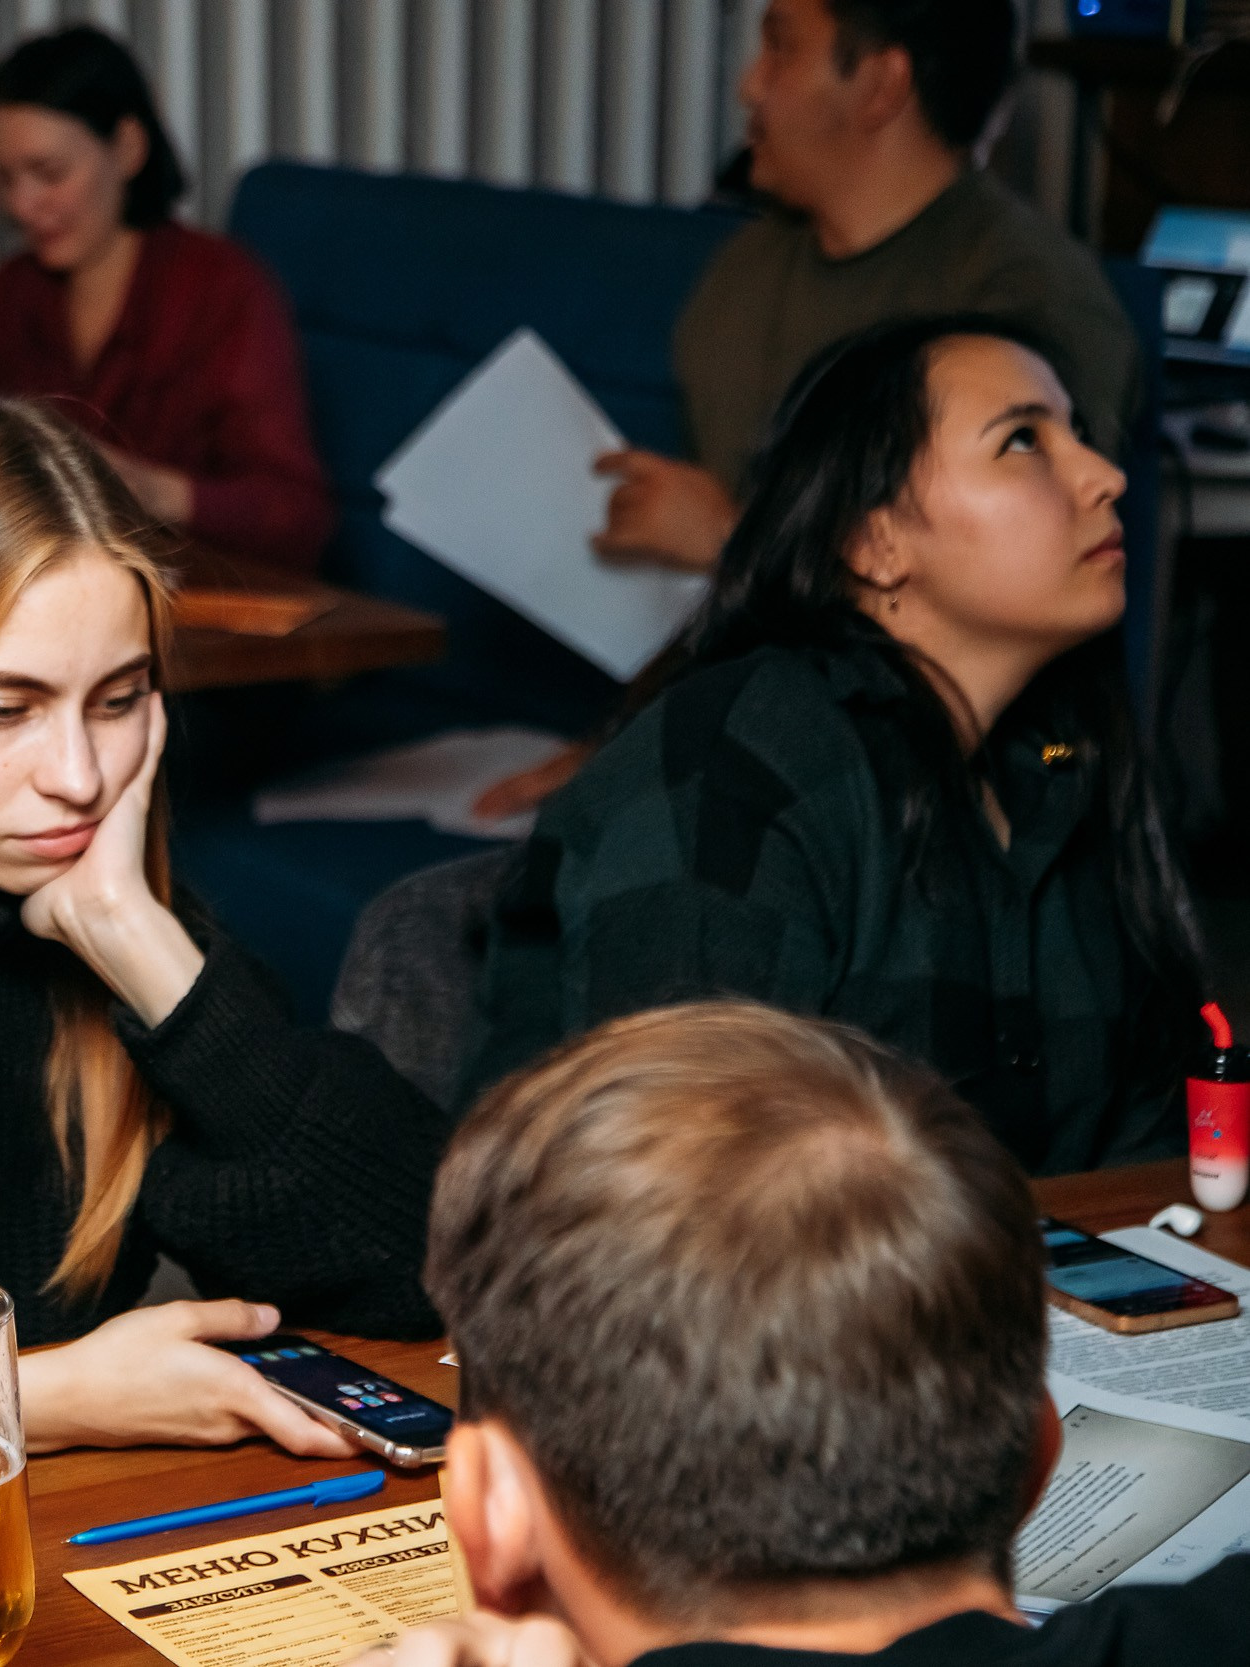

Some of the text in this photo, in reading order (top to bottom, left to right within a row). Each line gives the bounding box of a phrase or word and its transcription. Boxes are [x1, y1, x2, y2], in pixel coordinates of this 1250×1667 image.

[112, 1512, 445, 1596] МЕНЮ КУХНИ
[330, 1556, 390, 1576] МЯСО
[390, 1548, 425, 1564] НА
[165, 1583, 275, 1612] ЗАКУСИТЬ
